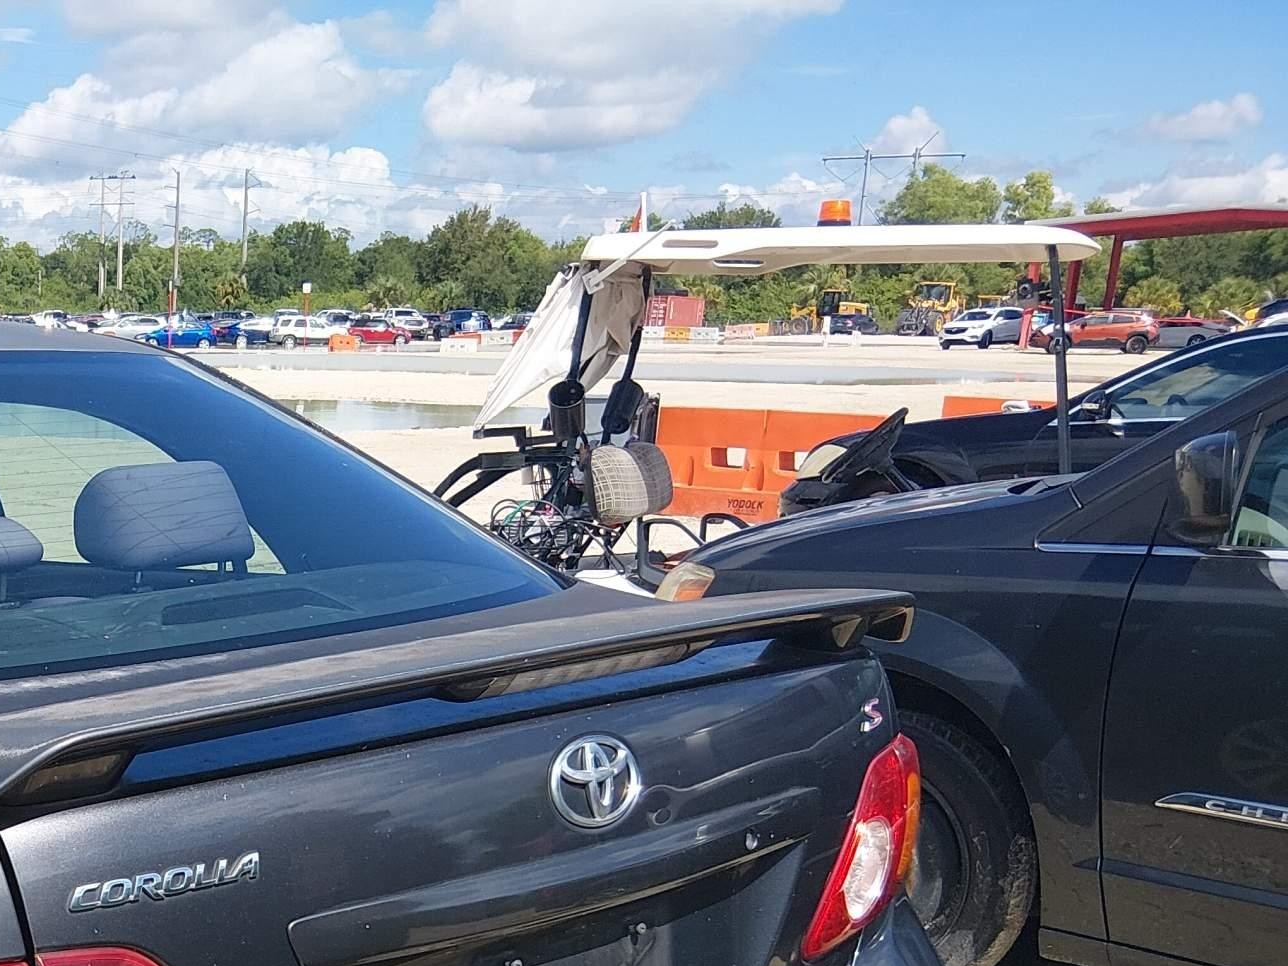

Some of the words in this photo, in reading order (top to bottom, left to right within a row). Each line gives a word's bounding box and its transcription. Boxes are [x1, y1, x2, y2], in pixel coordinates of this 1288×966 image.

[727, 498, 764, 511] YODOCK
[860, 697, 882, 732] S
[69, 851, 260, 912] COROLLA
